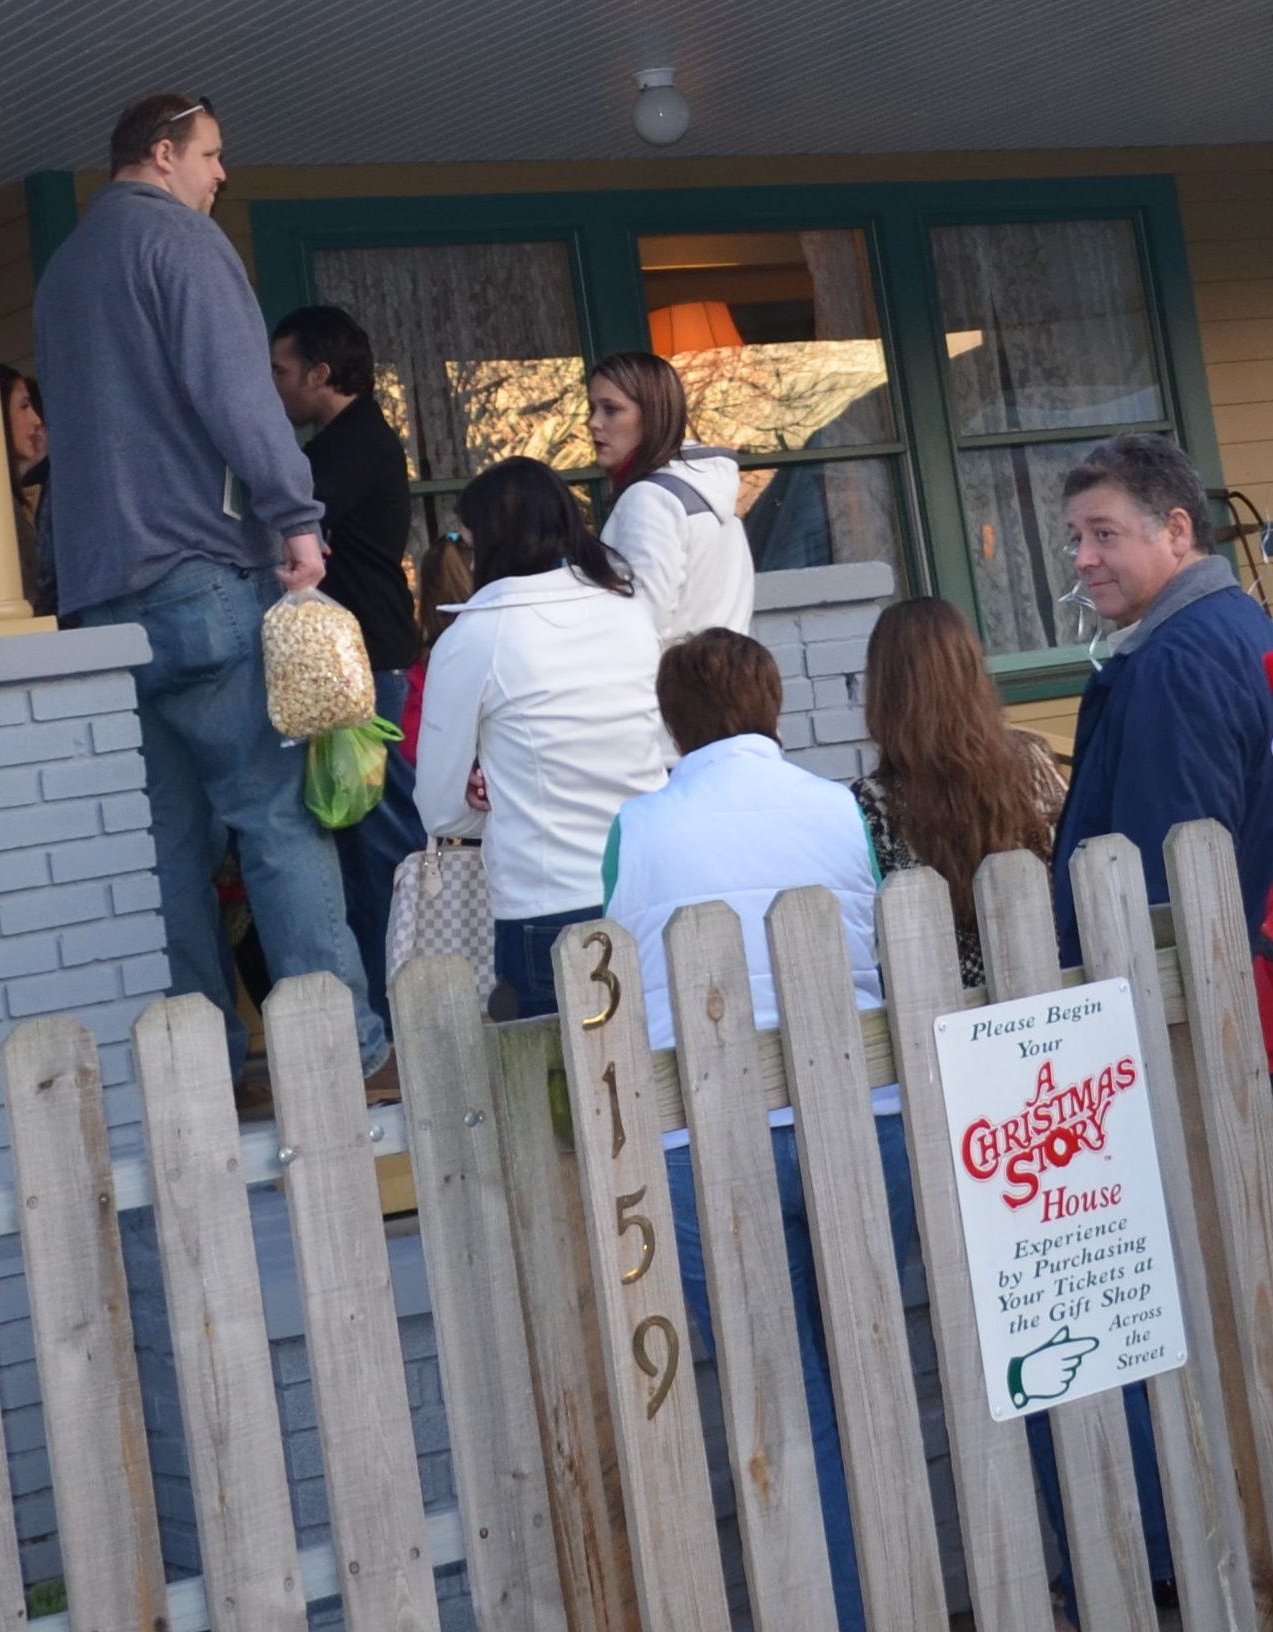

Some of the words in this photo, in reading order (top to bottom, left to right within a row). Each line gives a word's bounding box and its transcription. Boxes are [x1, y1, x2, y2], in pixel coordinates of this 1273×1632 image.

[970, 1016, 1035, 1042] Please
[1046, 998, 1102, 1025] Begin
[1017, 1037, 1063, 1058] Your
[1025, 1061, 1056, 1107] A
[961, 1058, 1136, 1180] CHRISTMAS
[582, 930, 680, 1421] 3159
[1002, 1100, 1111, 1209] STORY
[1040, 1183, 1122, 1224] House
[1013, 1218, 1128, 1260] Experience
[998, 1270, 1023, 1289] by
[1033, 1236, 1147, 1279] Purchasing
[998, 1287, 1045, 1313] Your
[1054, 1265, 1125, 1298] Tickets
[1133, 1257, 1154, 1274] at
[1008, 1314, 1040, 1335] the
[1049, 1296, 1091, 1323] Gift
[1100, 1283, 1152, 1309] Shop
[1108, 1305, 1163, 1332] Across
[1115, 1345, 1165, 1370] Street
[1125, 1329, 1151, 1348] the
